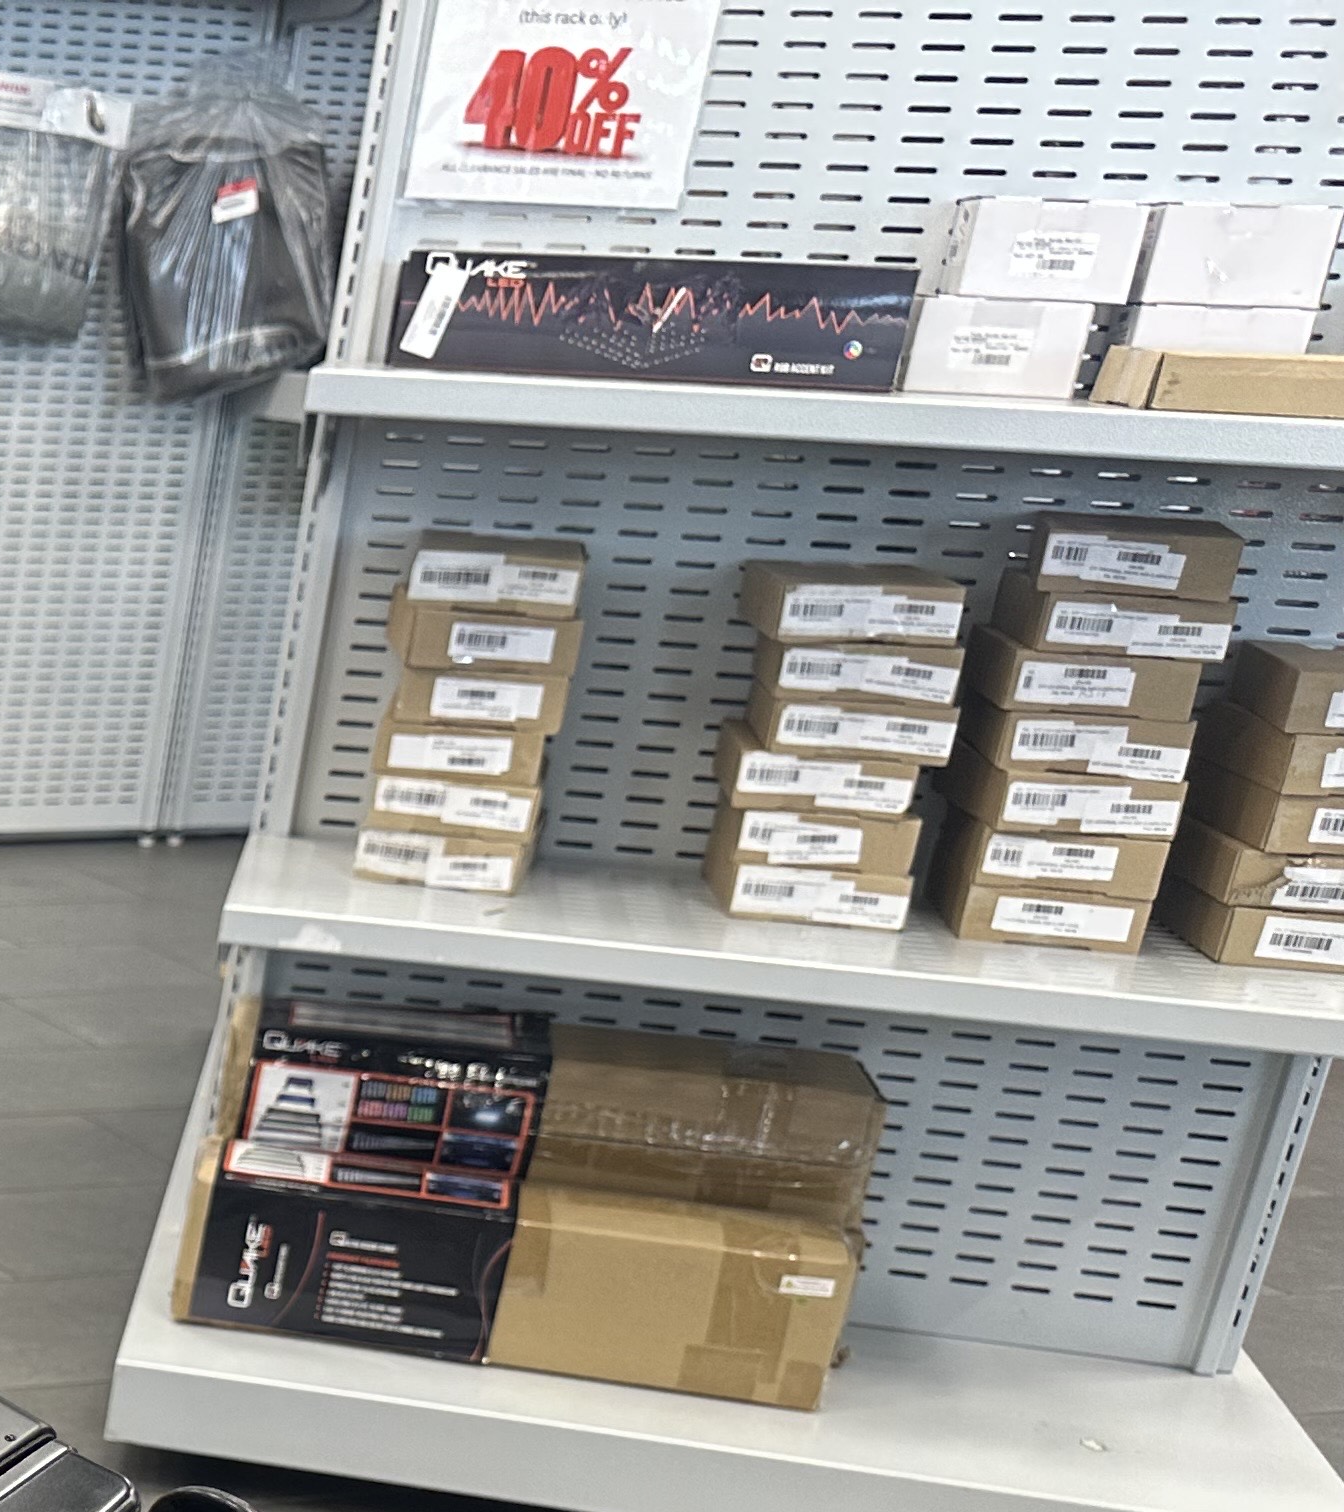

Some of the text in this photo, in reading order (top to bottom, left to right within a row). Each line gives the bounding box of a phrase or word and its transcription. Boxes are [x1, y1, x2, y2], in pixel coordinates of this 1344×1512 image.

[555, 9, 586, 26] rack
[463, 46, 633, 150] 40%
[564, 112, 642, 159] OFF
